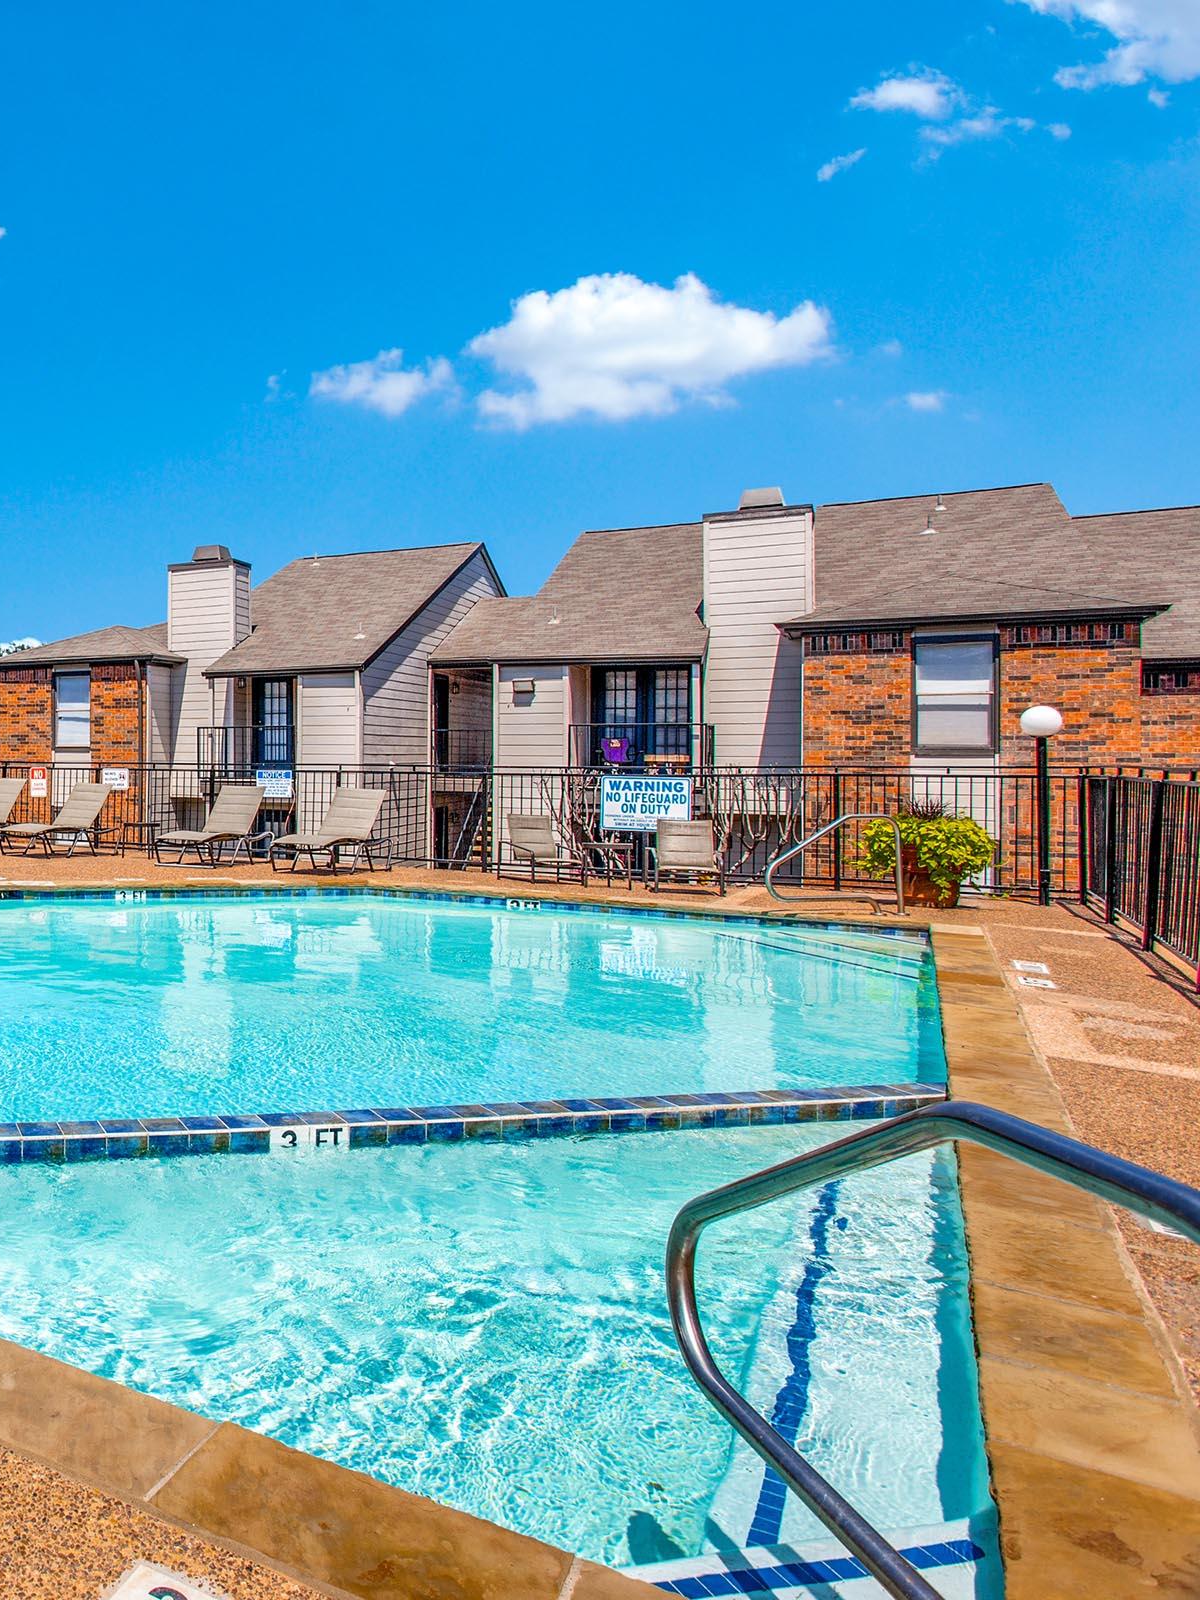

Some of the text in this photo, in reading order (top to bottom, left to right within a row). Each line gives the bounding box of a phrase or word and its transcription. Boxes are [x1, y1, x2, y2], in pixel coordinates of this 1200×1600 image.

[33, 769, 43, 779] NO
[262, 771, 286, 779] NOTICE
[608, 780, 685, 793] WARNING
[605, 791, 687, 805] NO LIFEGUARD
[620, 803, 671, 815] ON DUTY
[132, 890, 144, 899] FT
[281, 1127, 343, 1148] 3 FT
